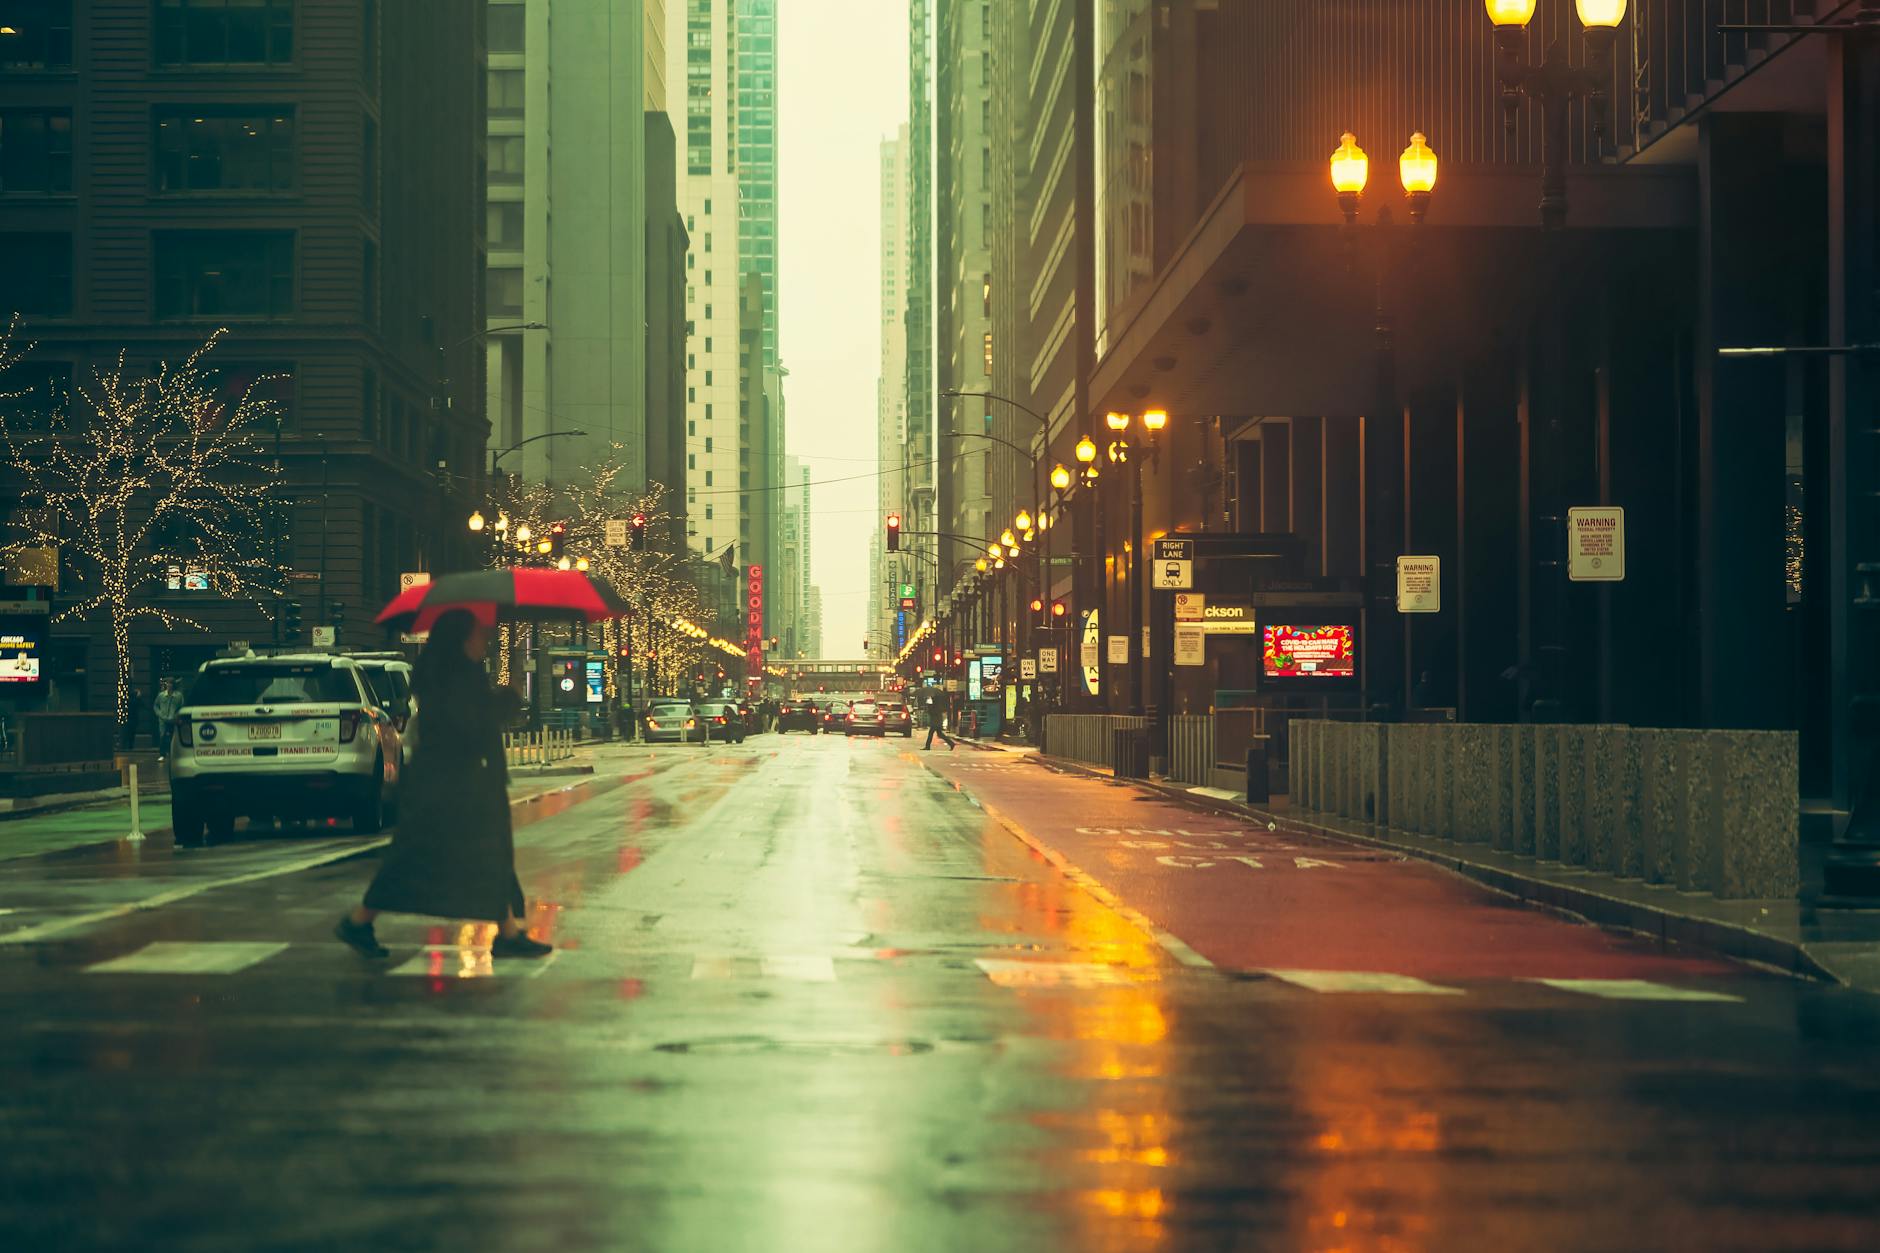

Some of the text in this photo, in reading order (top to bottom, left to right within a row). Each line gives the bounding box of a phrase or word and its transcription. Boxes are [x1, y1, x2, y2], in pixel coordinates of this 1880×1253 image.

[1577, 518, 1616, 527] WARNING
[1204, 606, 1244, 618] ckson
[1089, 622, 1098, 674] PAK
[196, 748, 250, 756] CHICAGO POLICE
